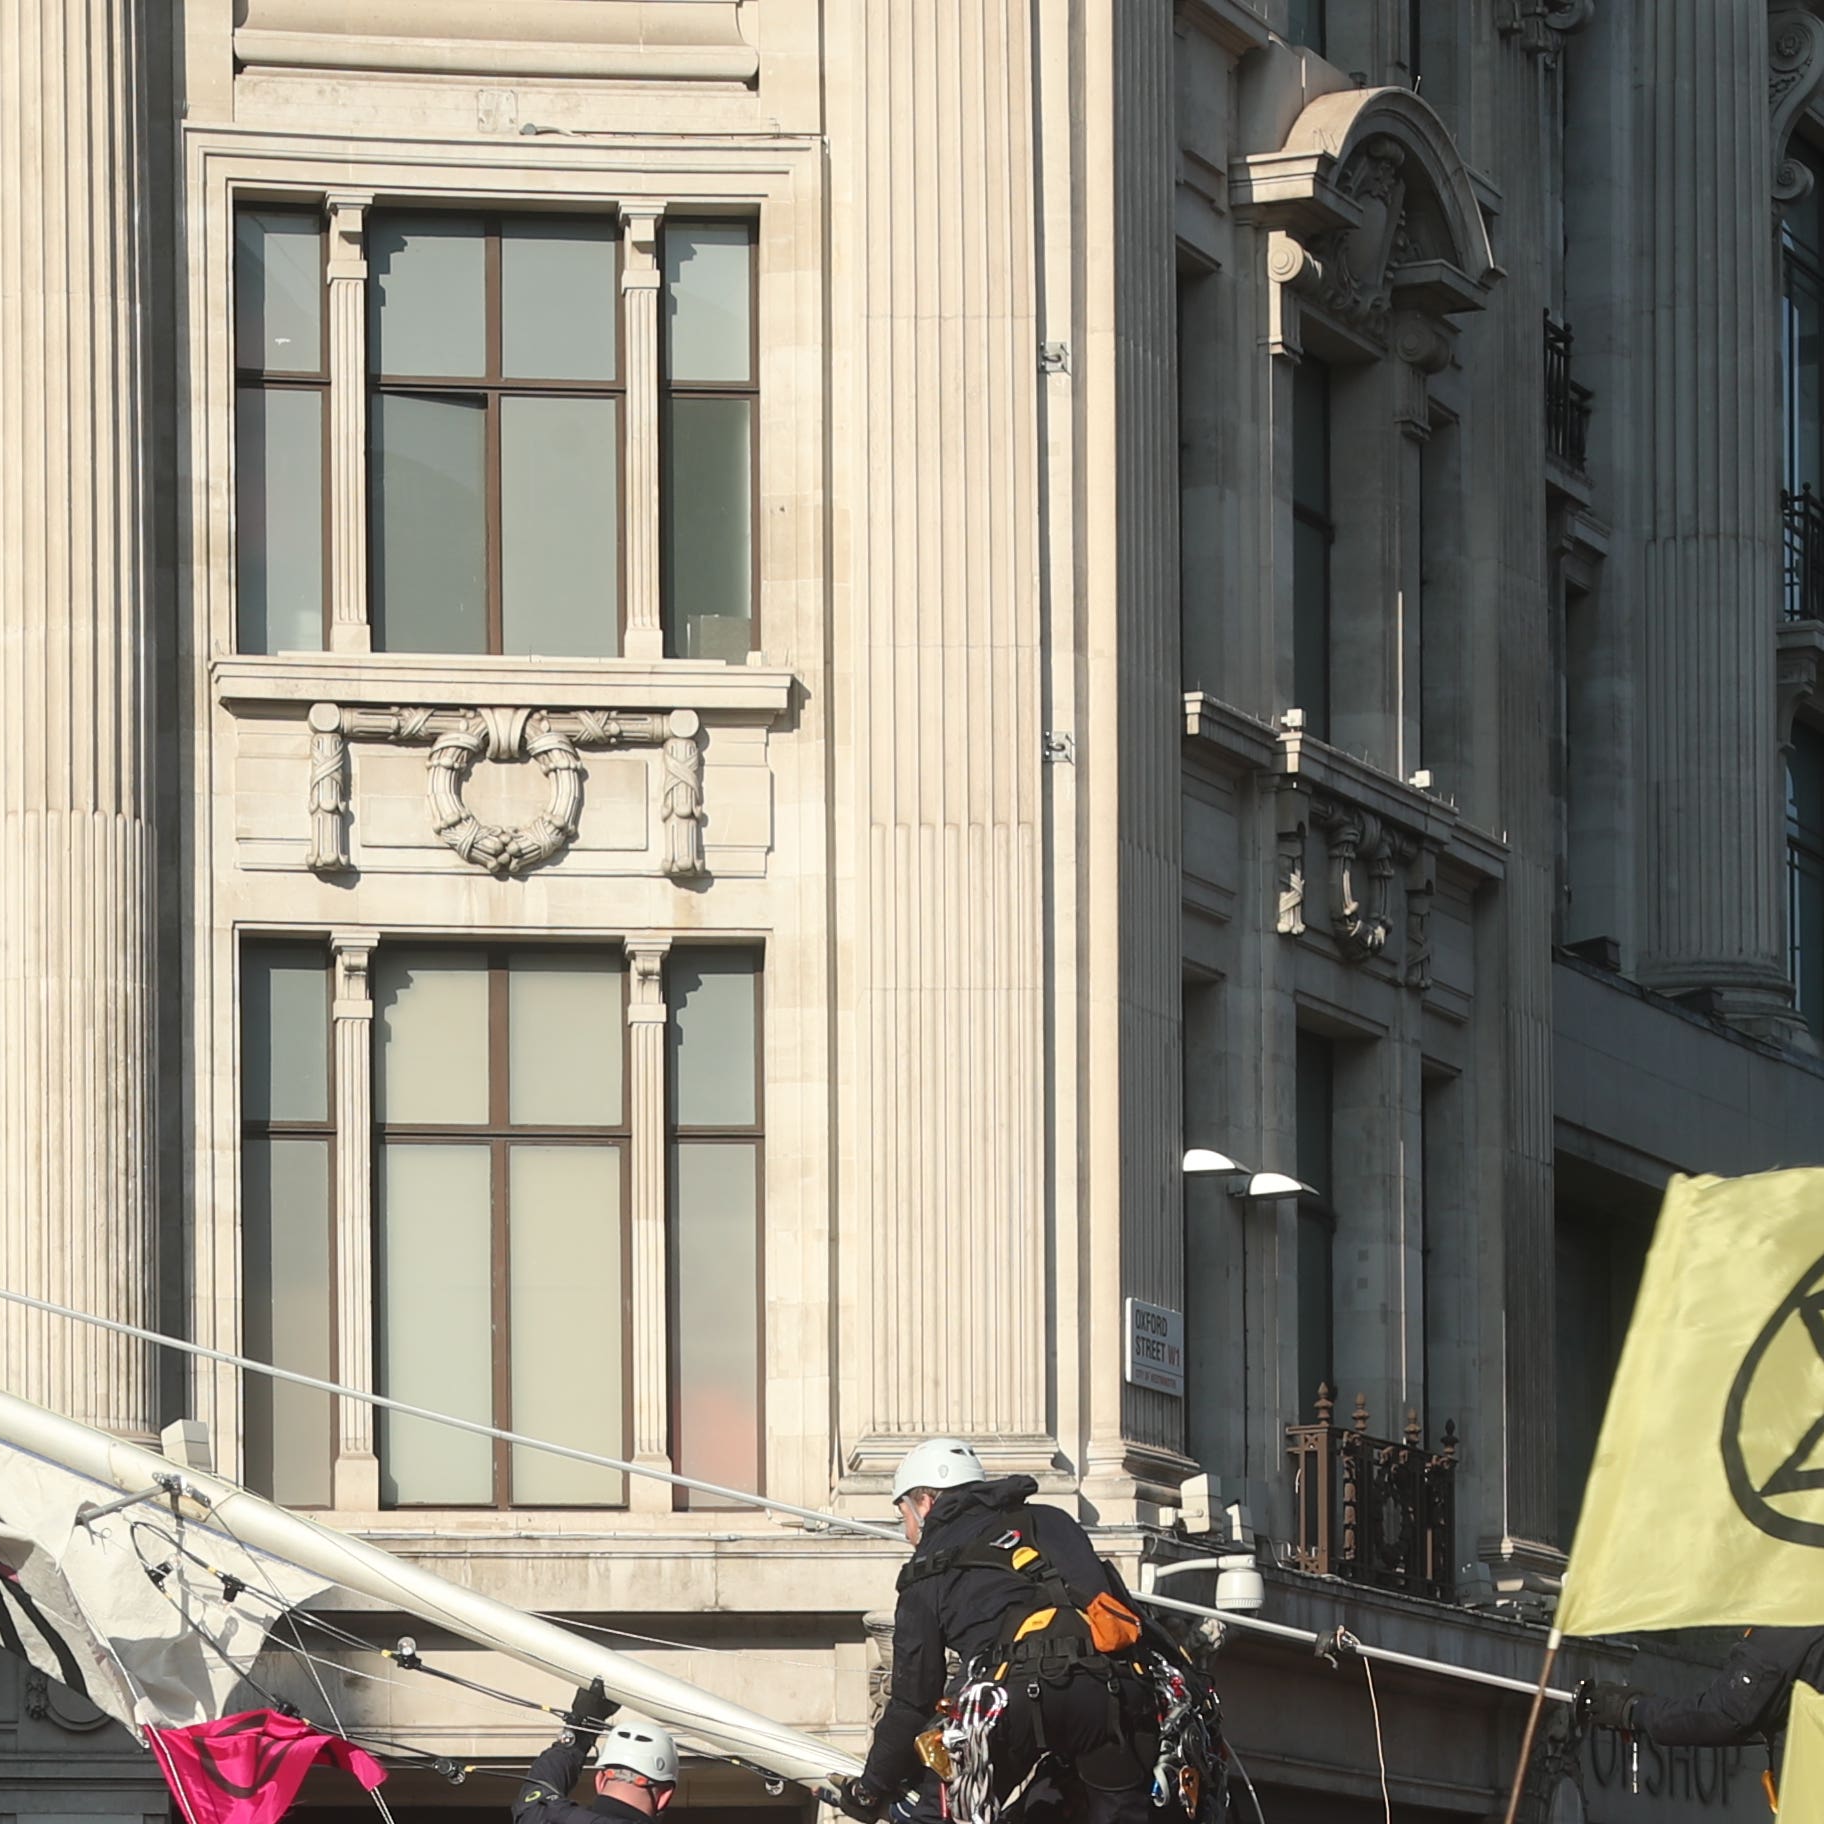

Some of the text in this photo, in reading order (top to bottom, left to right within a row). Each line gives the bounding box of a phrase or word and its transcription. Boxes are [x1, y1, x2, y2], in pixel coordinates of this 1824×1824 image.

[1136, 1309, 1167, 1338] OXFORD
[1136, 1336, 1180, 1366] STREET W1
